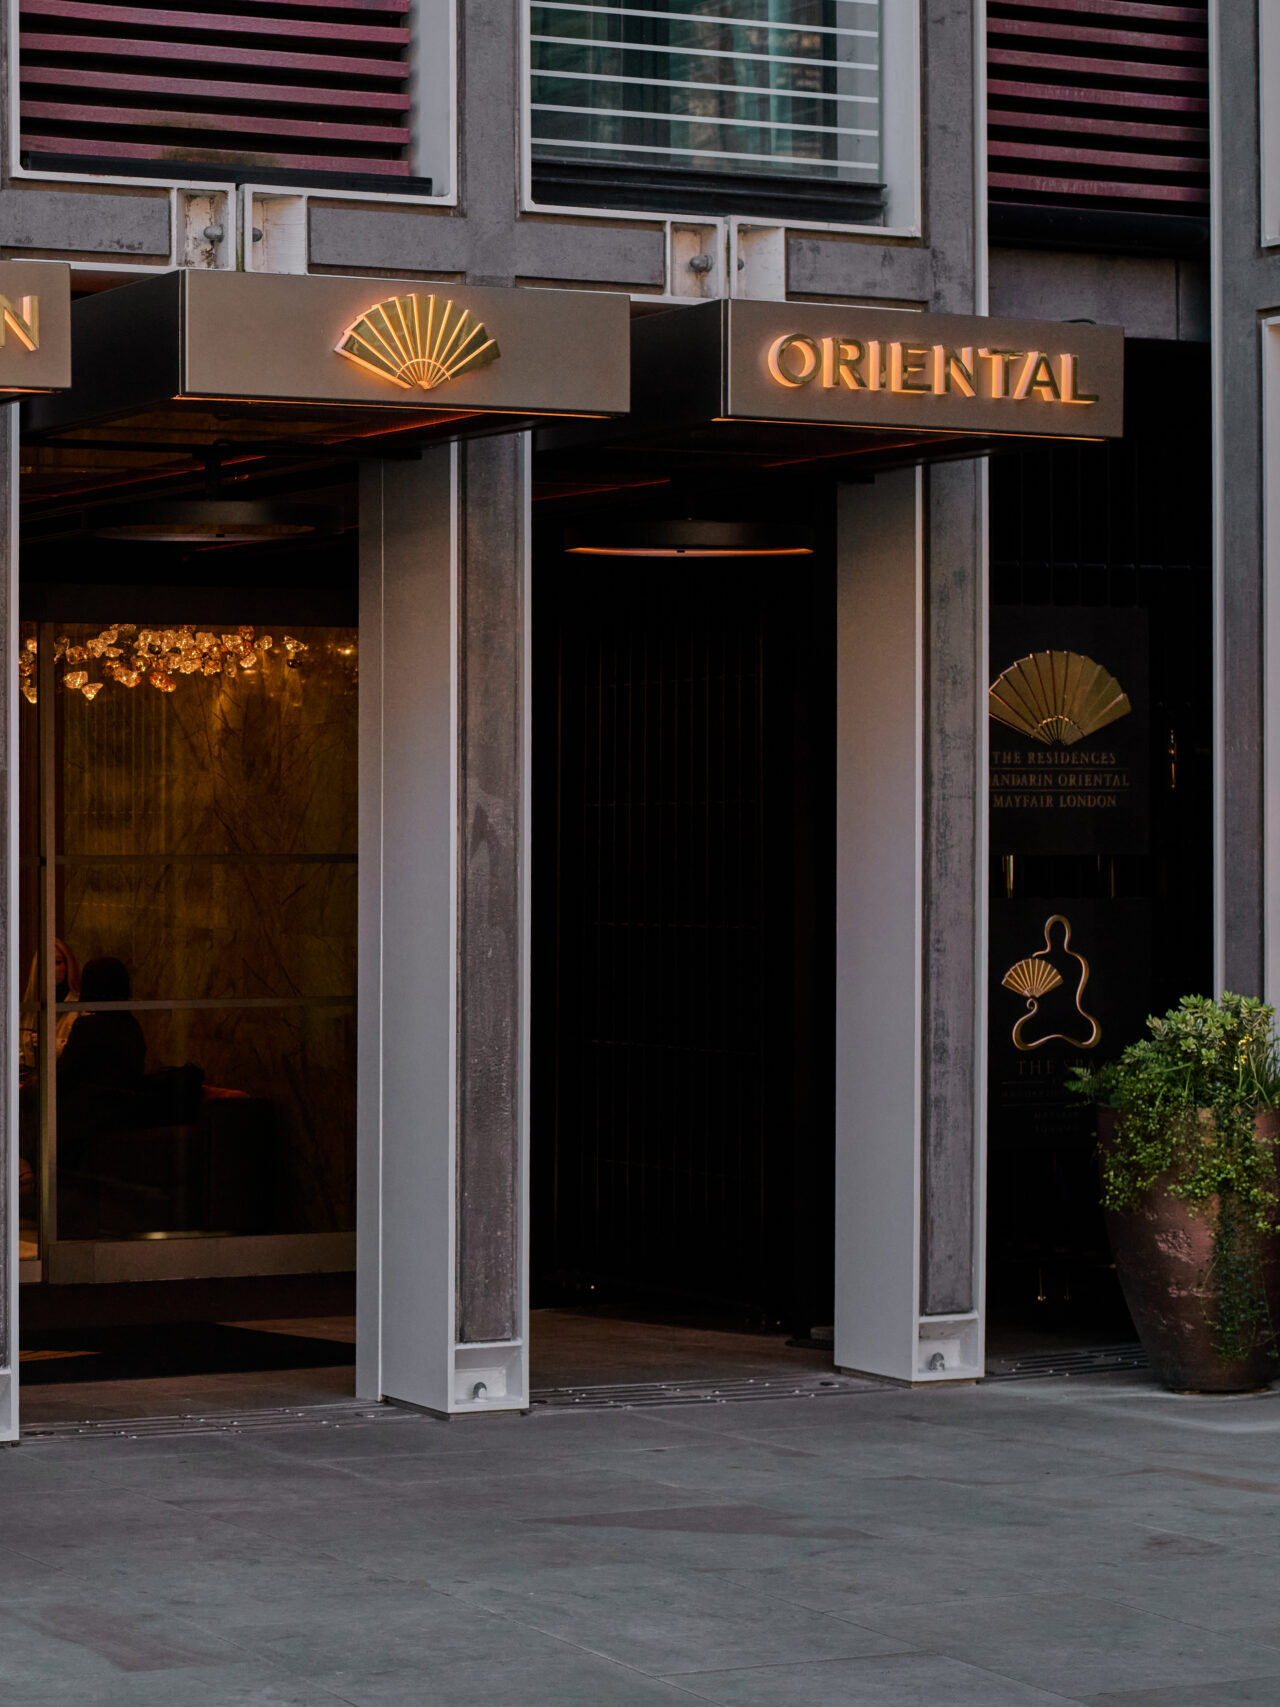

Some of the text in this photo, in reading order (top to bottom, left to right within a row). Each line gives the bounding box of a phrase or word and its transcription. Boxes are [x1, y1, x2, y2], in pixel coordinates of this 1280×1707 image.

[767, 333, 1099, 404] ORIENTAL
[992, 751, 1117, 764] THE RESIDENCES
[989, 773, 1130, 786] ANDARIN ORIENTAL
[992, 795, 1117, 808] MAYFAIR LONDON
